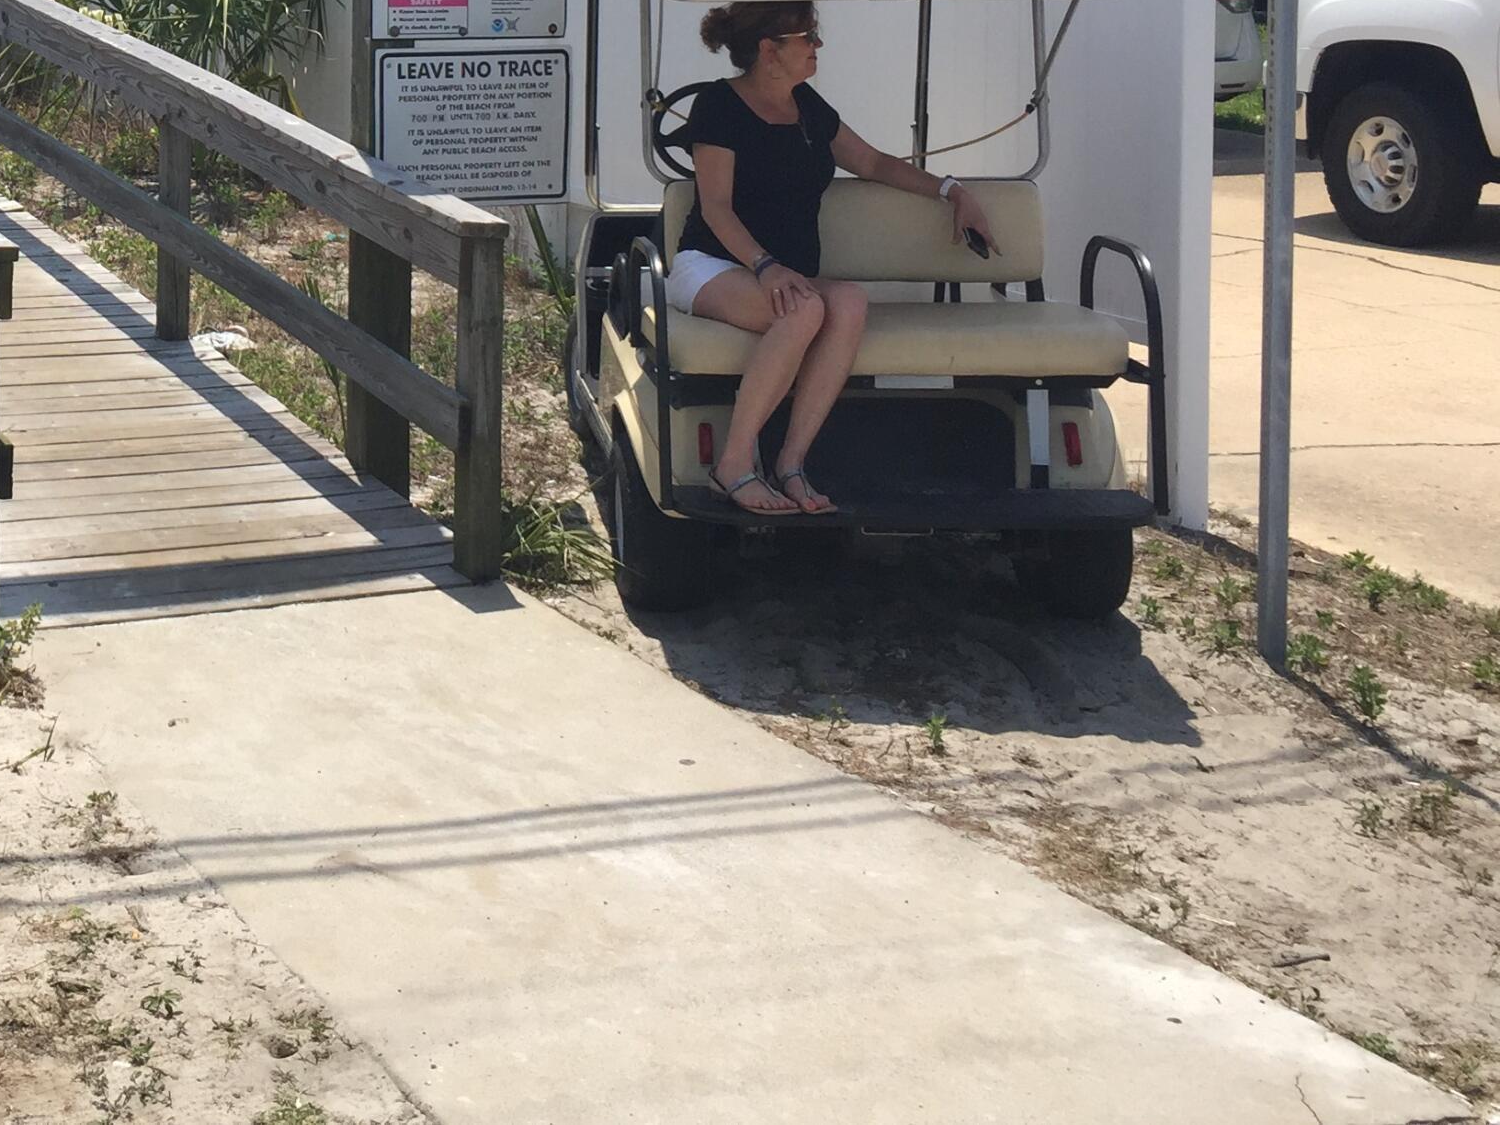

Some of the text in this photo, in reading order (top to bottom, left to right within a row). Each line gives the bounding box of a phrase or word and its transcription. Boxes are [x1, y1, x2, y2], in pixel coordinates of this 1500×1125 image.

[397, 59, 553, 80] LEAVE NO TRACE
[420, 84, 464, 92] UNLAWFUL
[504, 82, 517, 90] AN
[442, 93, 480, 101] PROPERTY
[450, 113, 473, 121] UNTIL
[441, 147, 469, 155] PUBLIC
[471, 146, 496, 154] BEACH
[420, 163, 462, 171] PERSONAL
[457, 185, 499, 193] ORDINANCE
